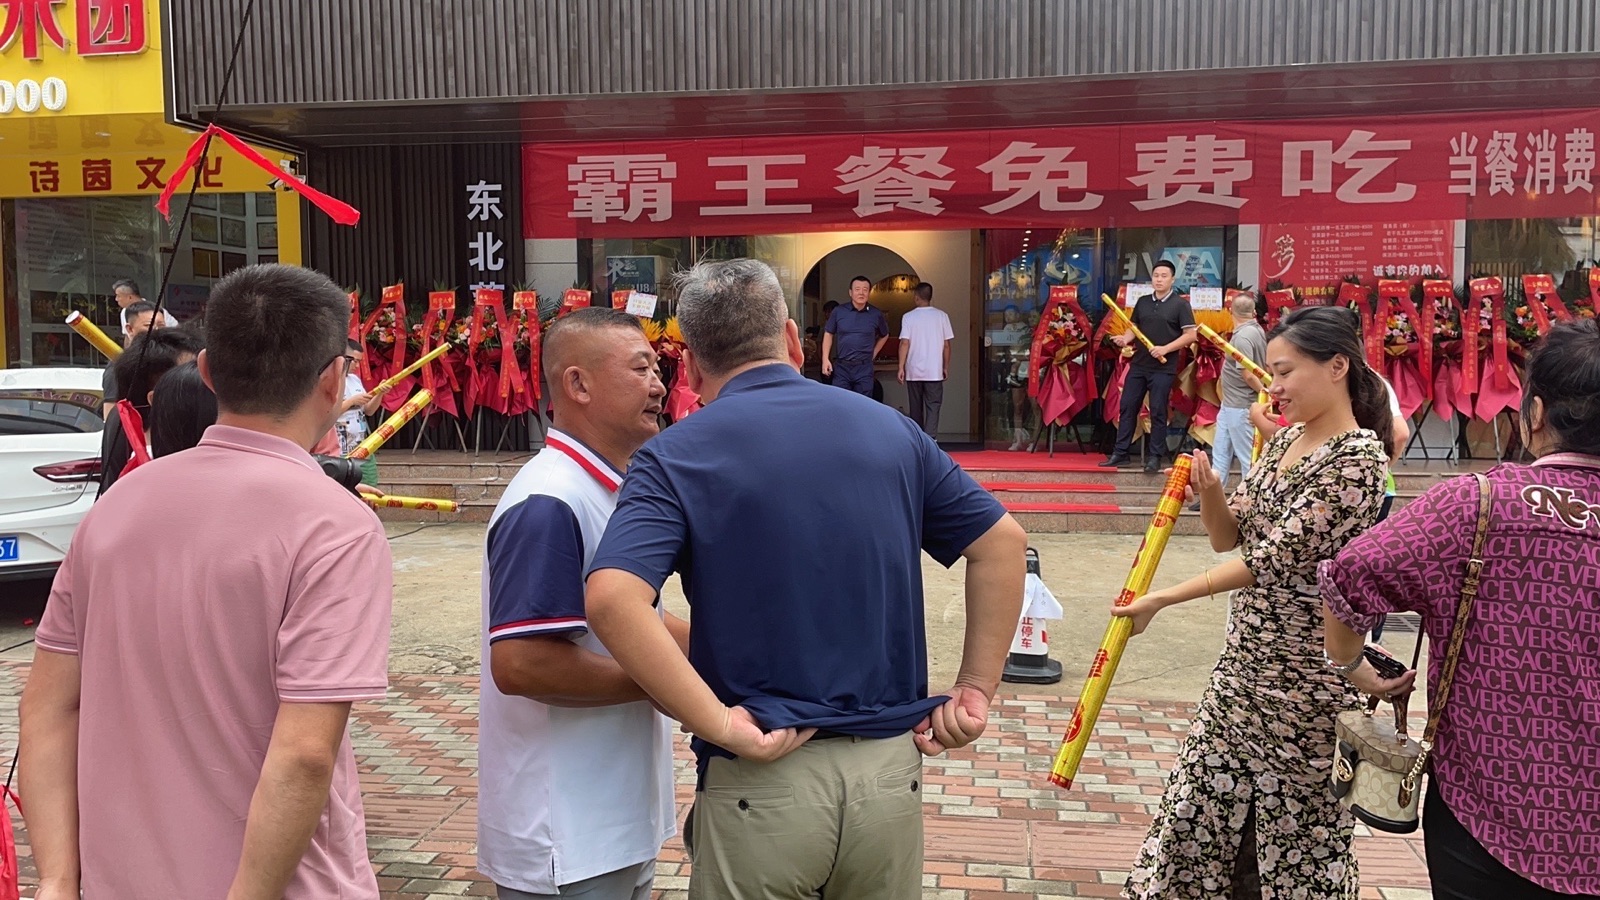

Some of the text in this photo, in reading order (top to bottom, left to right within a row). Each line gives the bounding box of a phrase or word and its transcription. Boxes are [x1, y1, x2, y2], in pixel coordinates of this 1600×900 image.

[567, 130, 1417, 224] 霸王餐免费吃
[1448, 128, 1596, 197] 当餐消费
[466, 180, 505, 292] 东北
